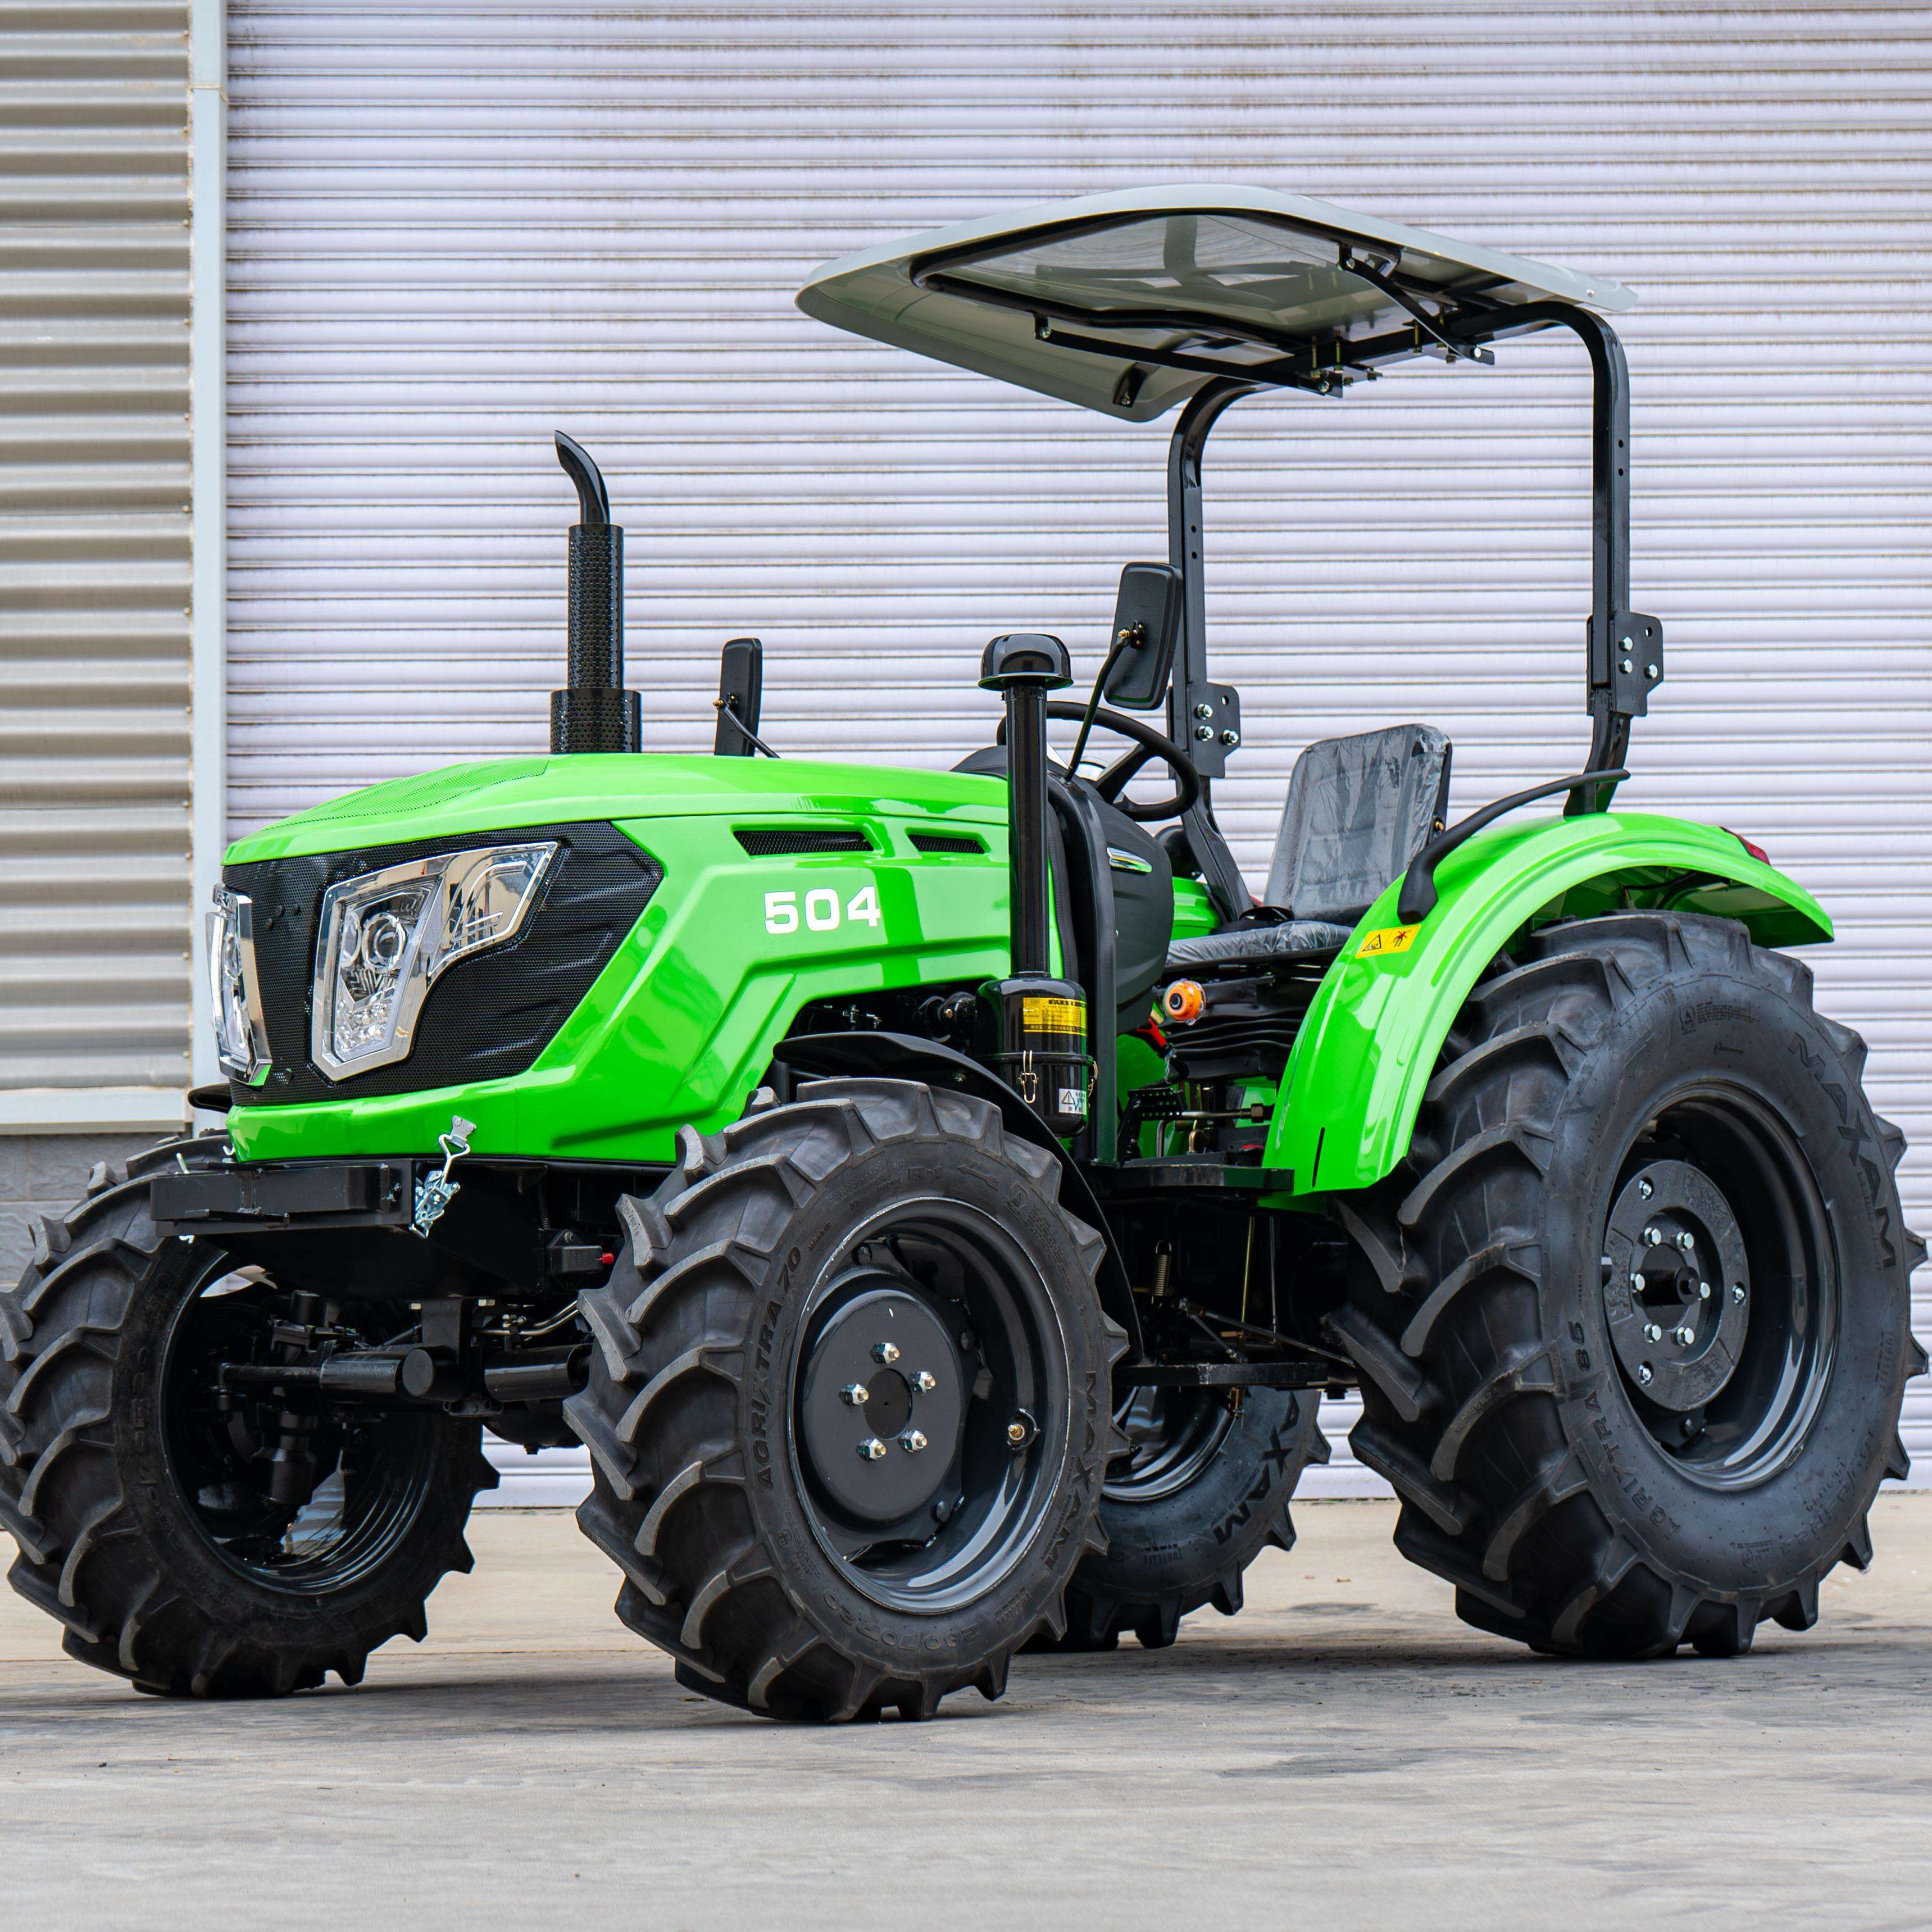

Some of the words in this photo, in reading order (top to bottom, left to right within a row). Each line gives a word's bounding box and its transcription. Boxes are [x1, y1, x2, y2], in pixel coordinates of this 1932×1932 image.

[764, 885, 880, 934] 504
[1787, 1031, 1897, 1269] MAXAM
[752, 1298, 783, 1489] AGRIXTRA
[776, 1246, 802, 1293] 70
[1567, 1320, 1591, 1372] 85
[1044, 1371, 1097, 1570] MAXAM
[823, 1588, 981, 1656] 280/70R20
